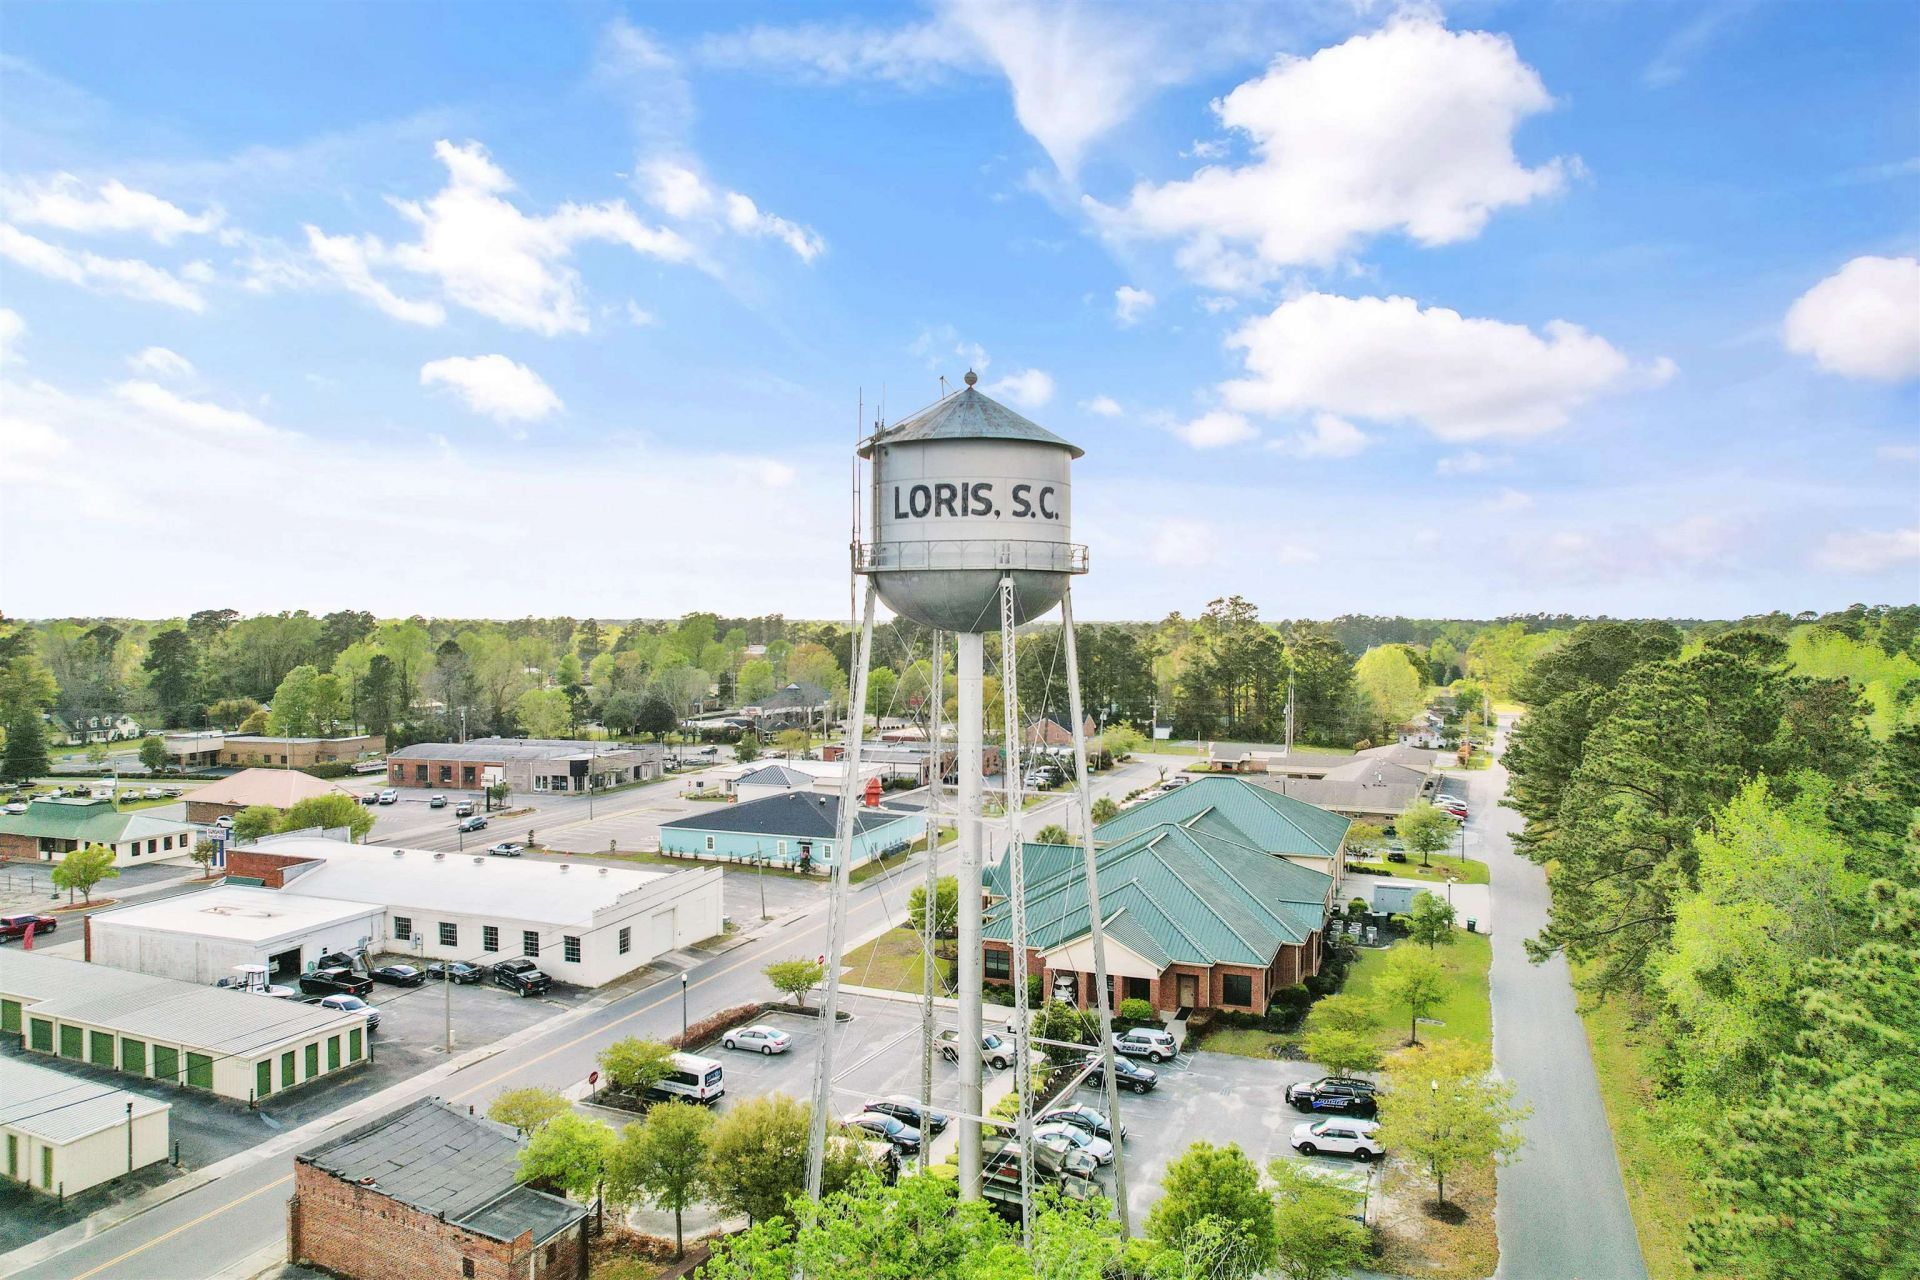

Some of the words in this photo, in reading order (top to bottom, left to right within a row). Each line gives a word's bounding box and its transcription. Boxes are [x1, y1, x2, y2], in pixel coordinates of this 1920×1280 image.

[894, 482, 1001, 520] LORIS,
[1012, 484, 1059, 520] S.C.
[1121, 1045, 1148, 1053] POLICE
